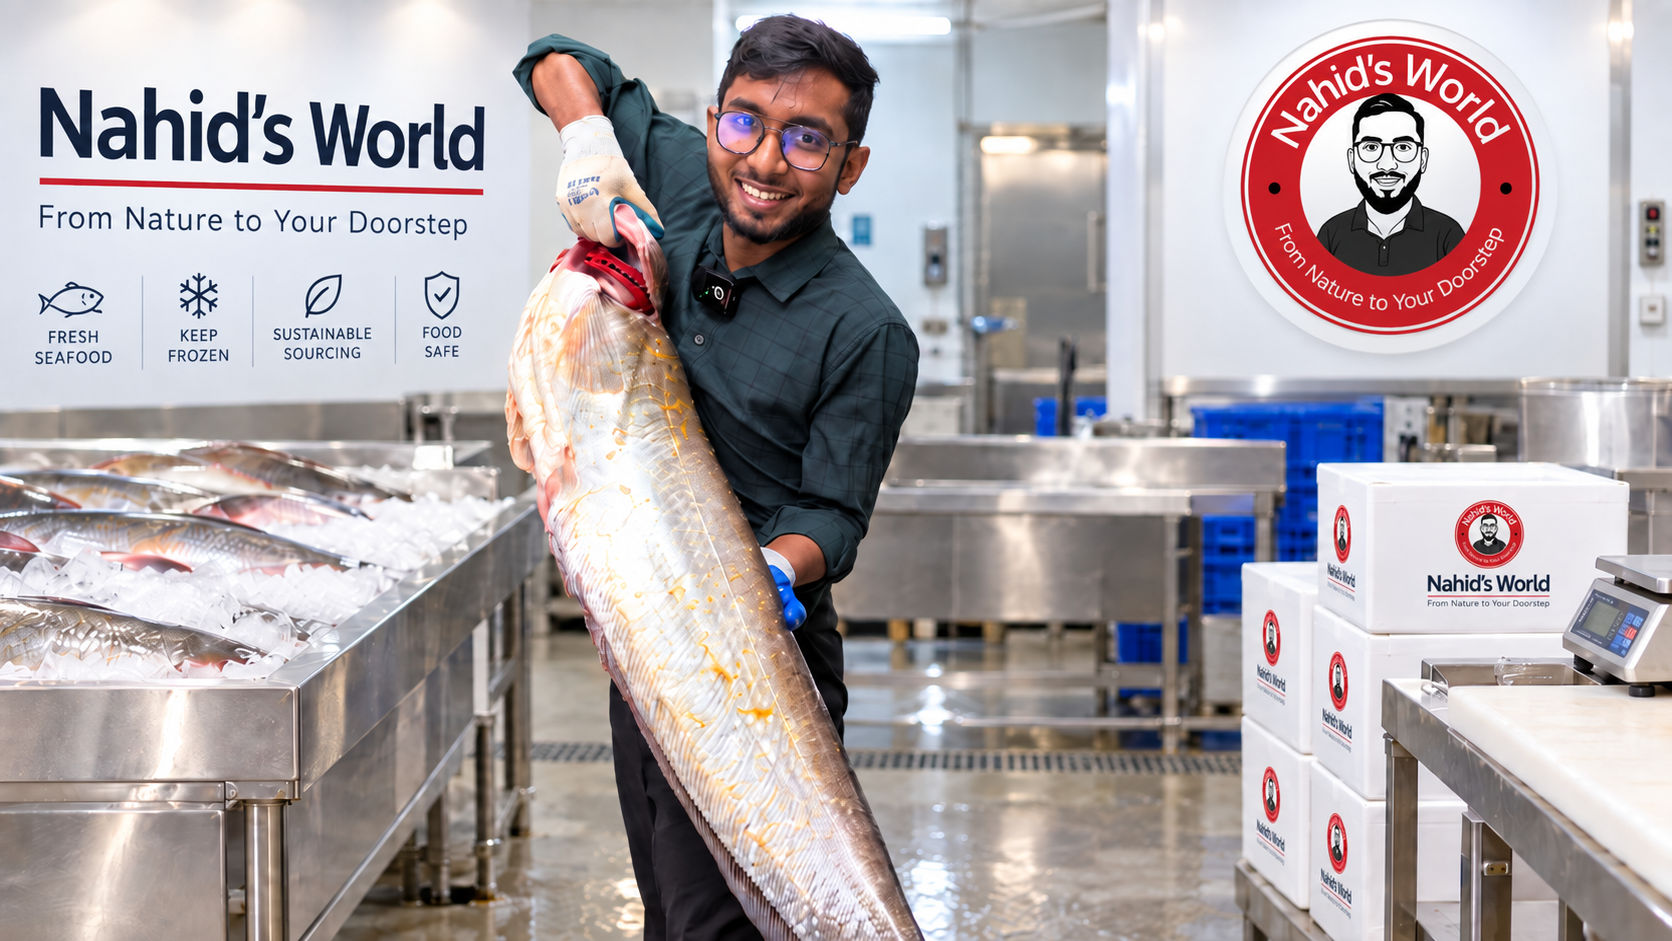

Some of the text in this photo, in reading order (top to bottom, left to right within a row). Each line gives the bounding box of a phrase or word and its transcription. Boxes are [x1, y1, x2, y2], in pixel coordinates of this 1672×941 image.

[1270, 53, 1511, 149] Nahid's World
[40, 86, 485, 171] Nahid's World
[39, 205, 468, 240] From Nature to Your Doorstep
[1275, 223, 1505, 311] From Nature to Your Doorstep
[48, 329, 99, 344] FRESH
[180, 328, 218, 342] KEEP
[273, 327, 372, 341] SUSTAINABLE
[422, 325, 462, 339] FOOD
[34, 350, 113, 365] SEAFOOD
[168, 348, 229, 363] FROZEN
[283, 346, 361, 361] SOURCING
[424, 345, 459, 358] SAFE
[1427, 574, 1550, 592] Nahid's World
[1427, 599, 1449, 607] From
[1451, 599, 1479, 607] Nature
[1492, 599, 1510, 607] Your
[1512, 599, 1550, 608] Doorstep
